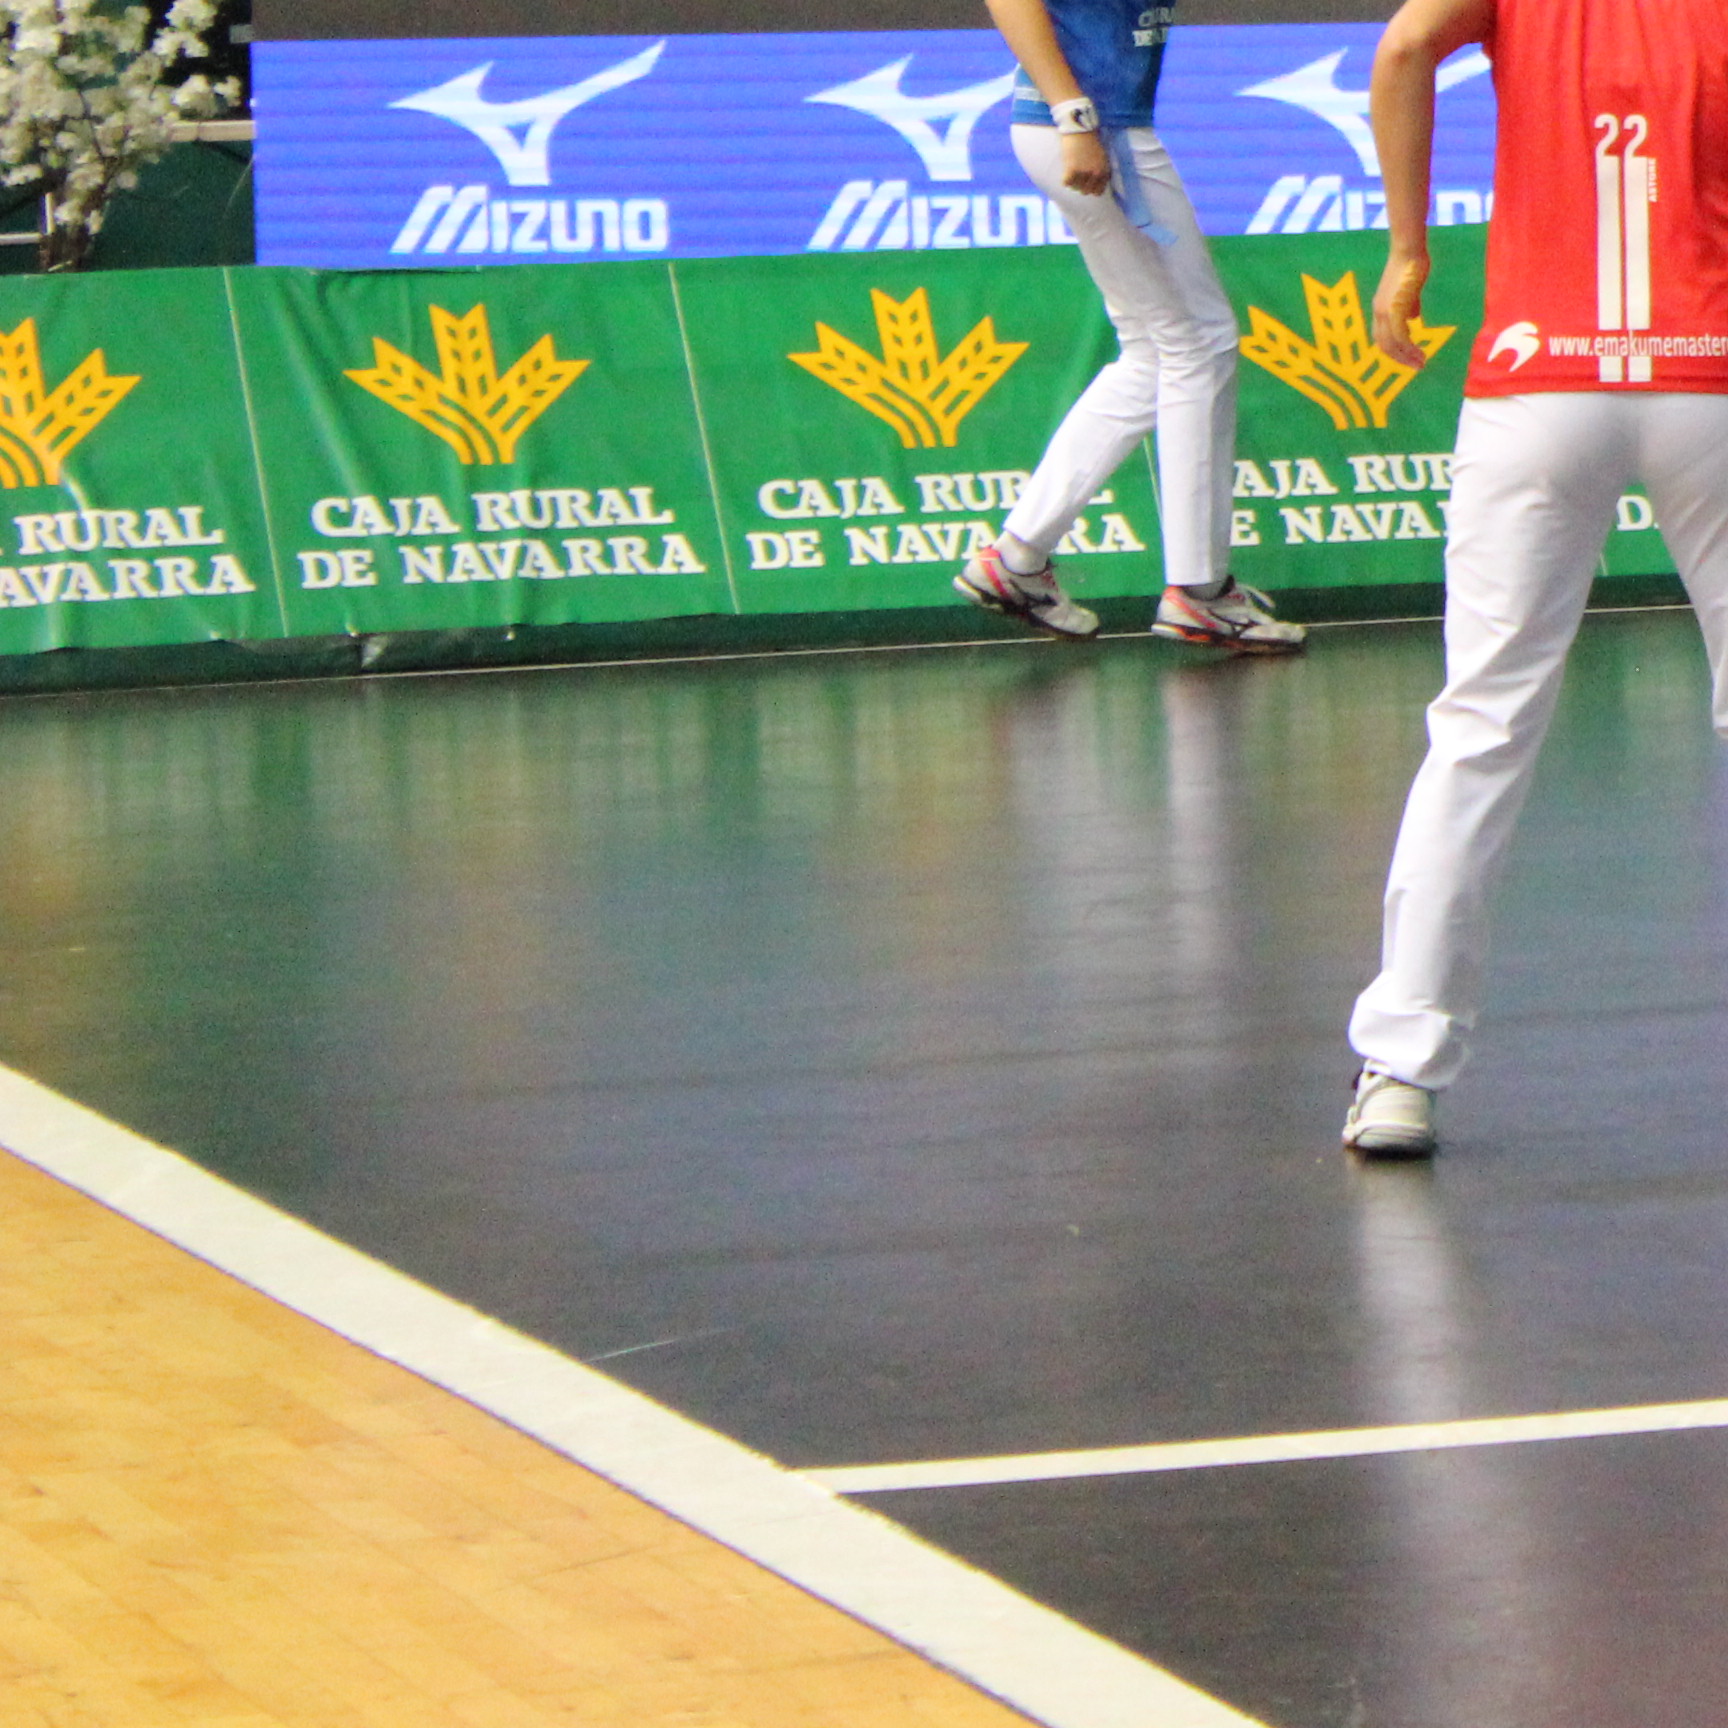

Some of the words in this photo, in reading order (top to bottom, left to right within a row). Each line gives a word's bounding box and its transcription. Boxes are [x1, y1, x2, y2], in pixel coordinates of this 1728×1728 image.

[759, 477, 904, 519] CAJA
[914, 469, 1114, 513] RUR
[1232, 457, 1340, 500] AJA
[14, 501, 224, 555] RURAL
[312, 495, 462, 536] CAJA
[473, 487, 674, 531] RURAL
[1229, 510, 1259, 546] E
[1277, 499, 1451, 546] NAVA
[298, 549, 376, 588] DE
[400, 534, 705, 583] NAVARRA
[746, 530, 825, 569] DE
[843, 512, 1148, 566] NAVARA
